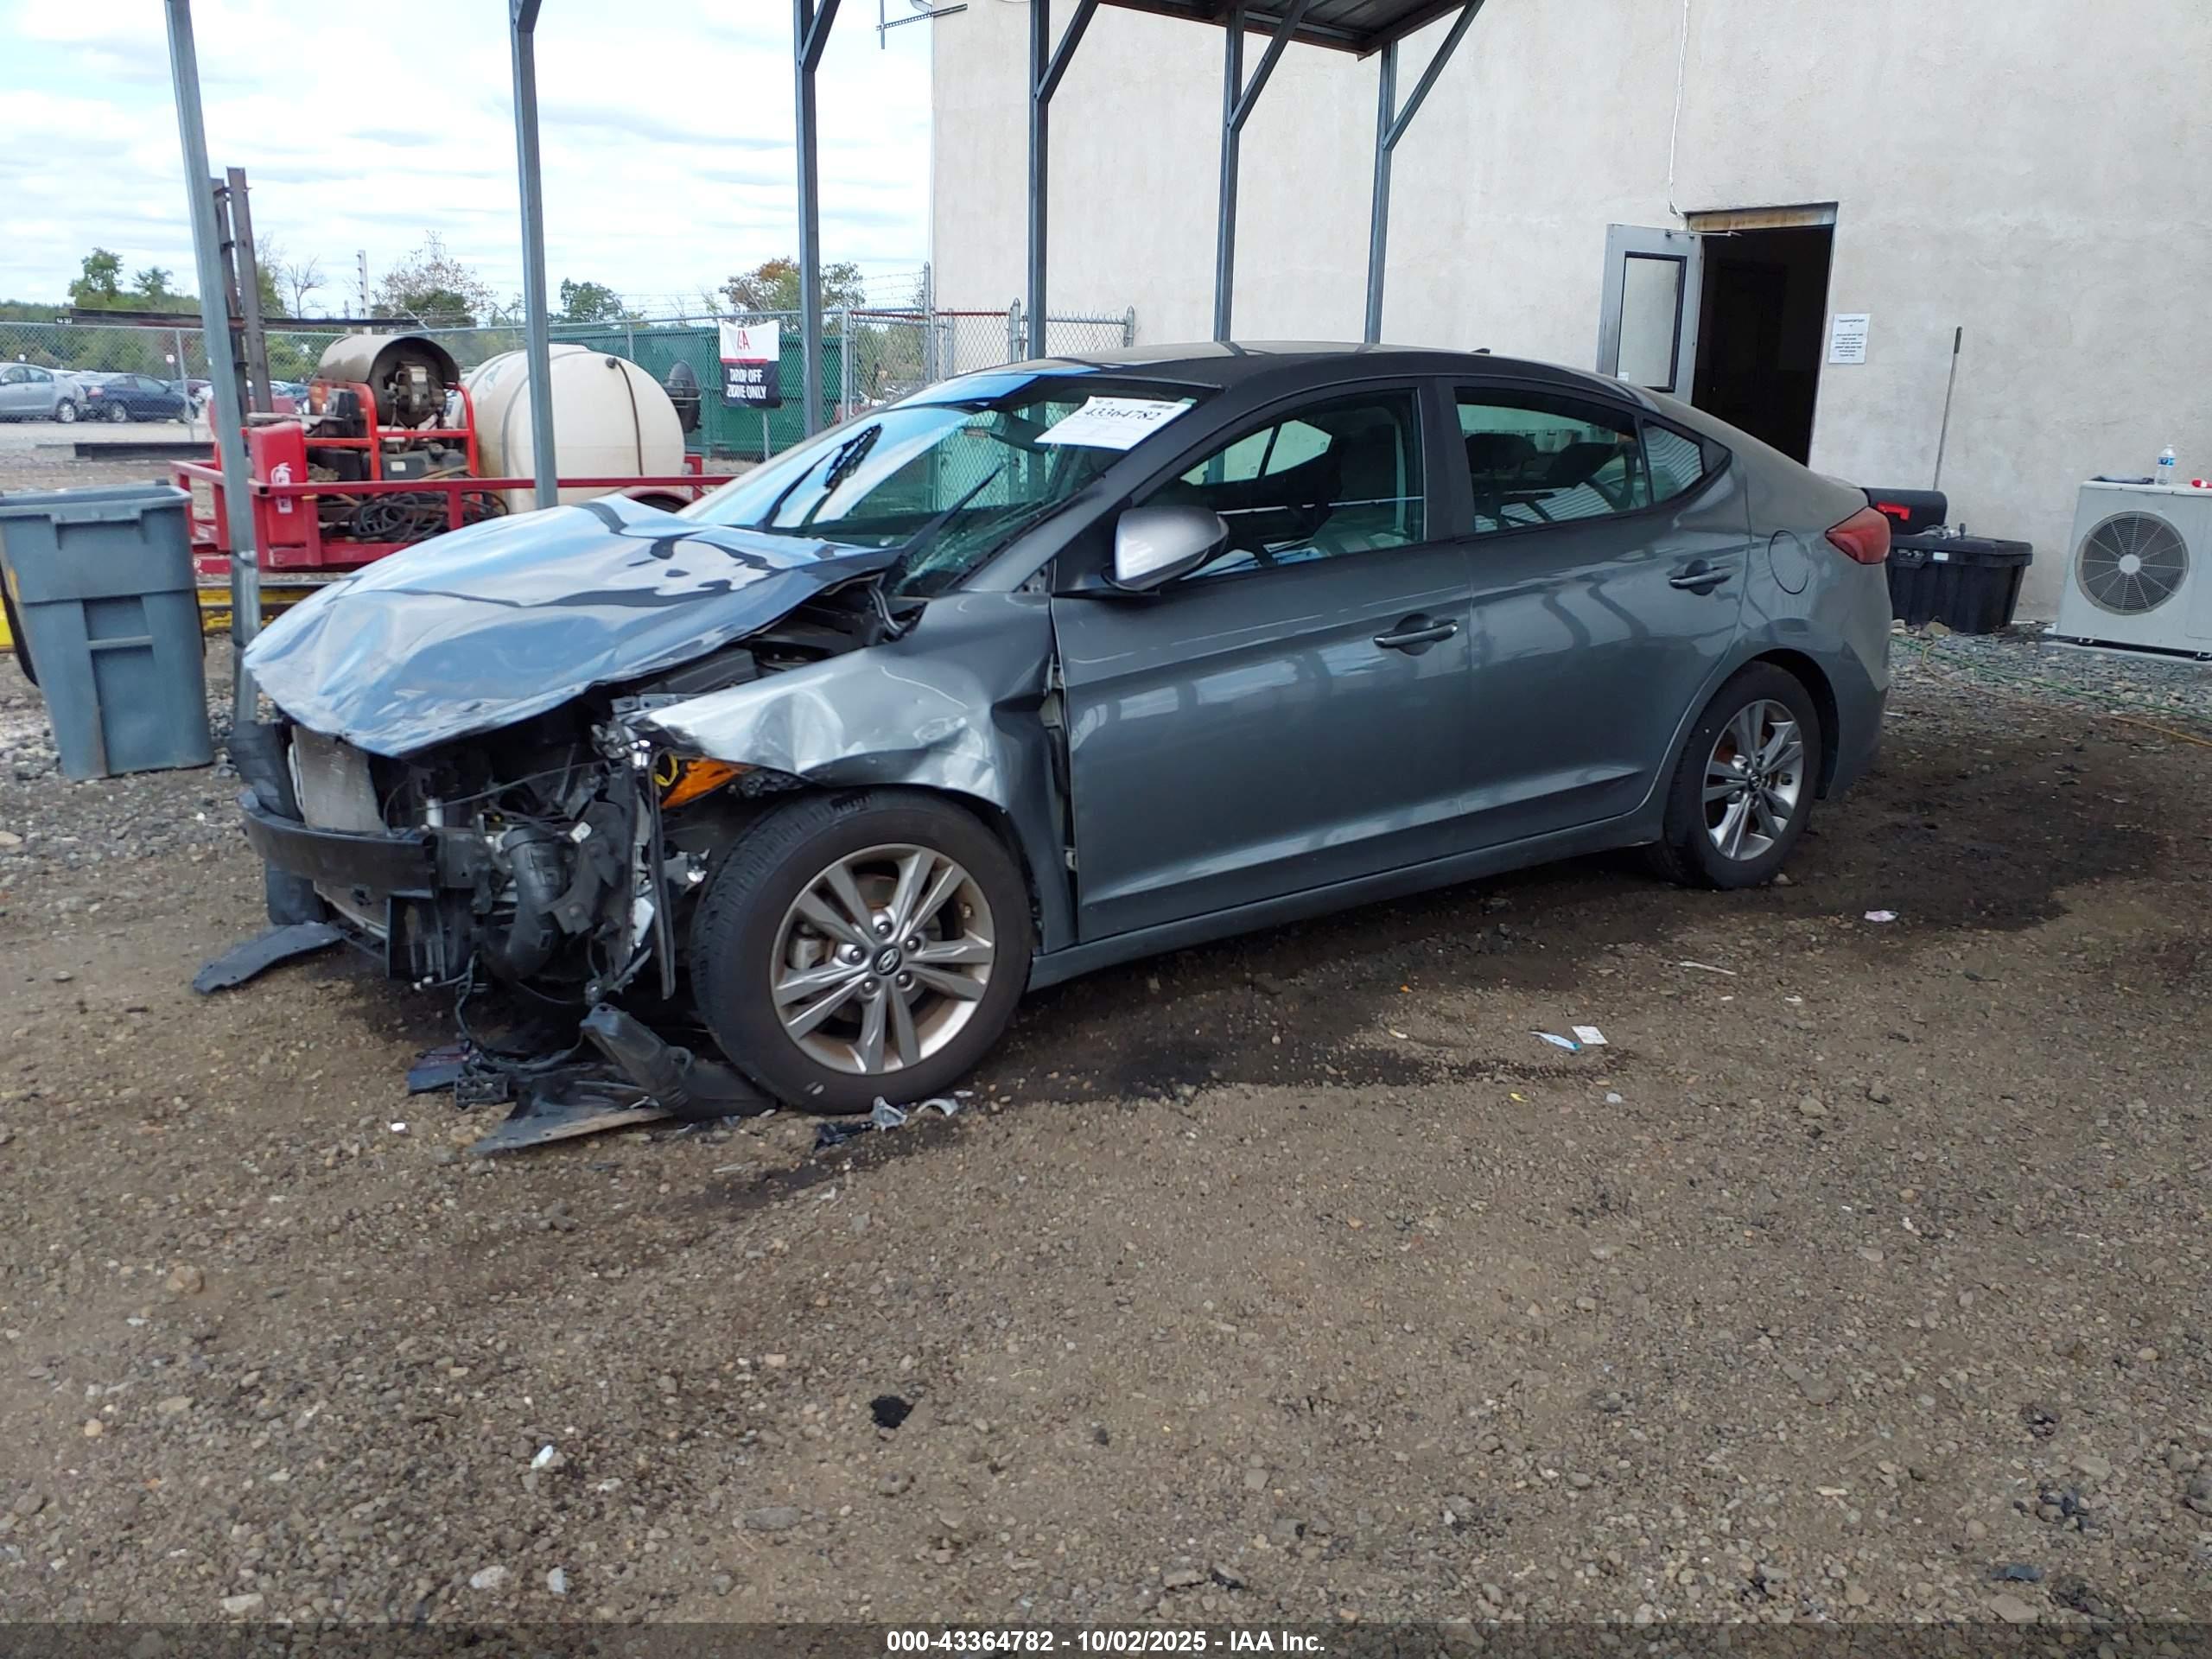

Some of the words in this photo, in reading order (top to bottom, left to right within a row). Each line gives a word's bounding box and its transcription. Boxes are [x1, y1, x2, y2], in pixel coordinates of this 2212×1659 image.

[729, 368, 747, 383] DROP
[747, 369, 763, 383] OFF
[727, 384, 747, 398] ZONE
[747, 385, 767, 399] ONLY
[1084, 407, 1161, 421] 43364782
